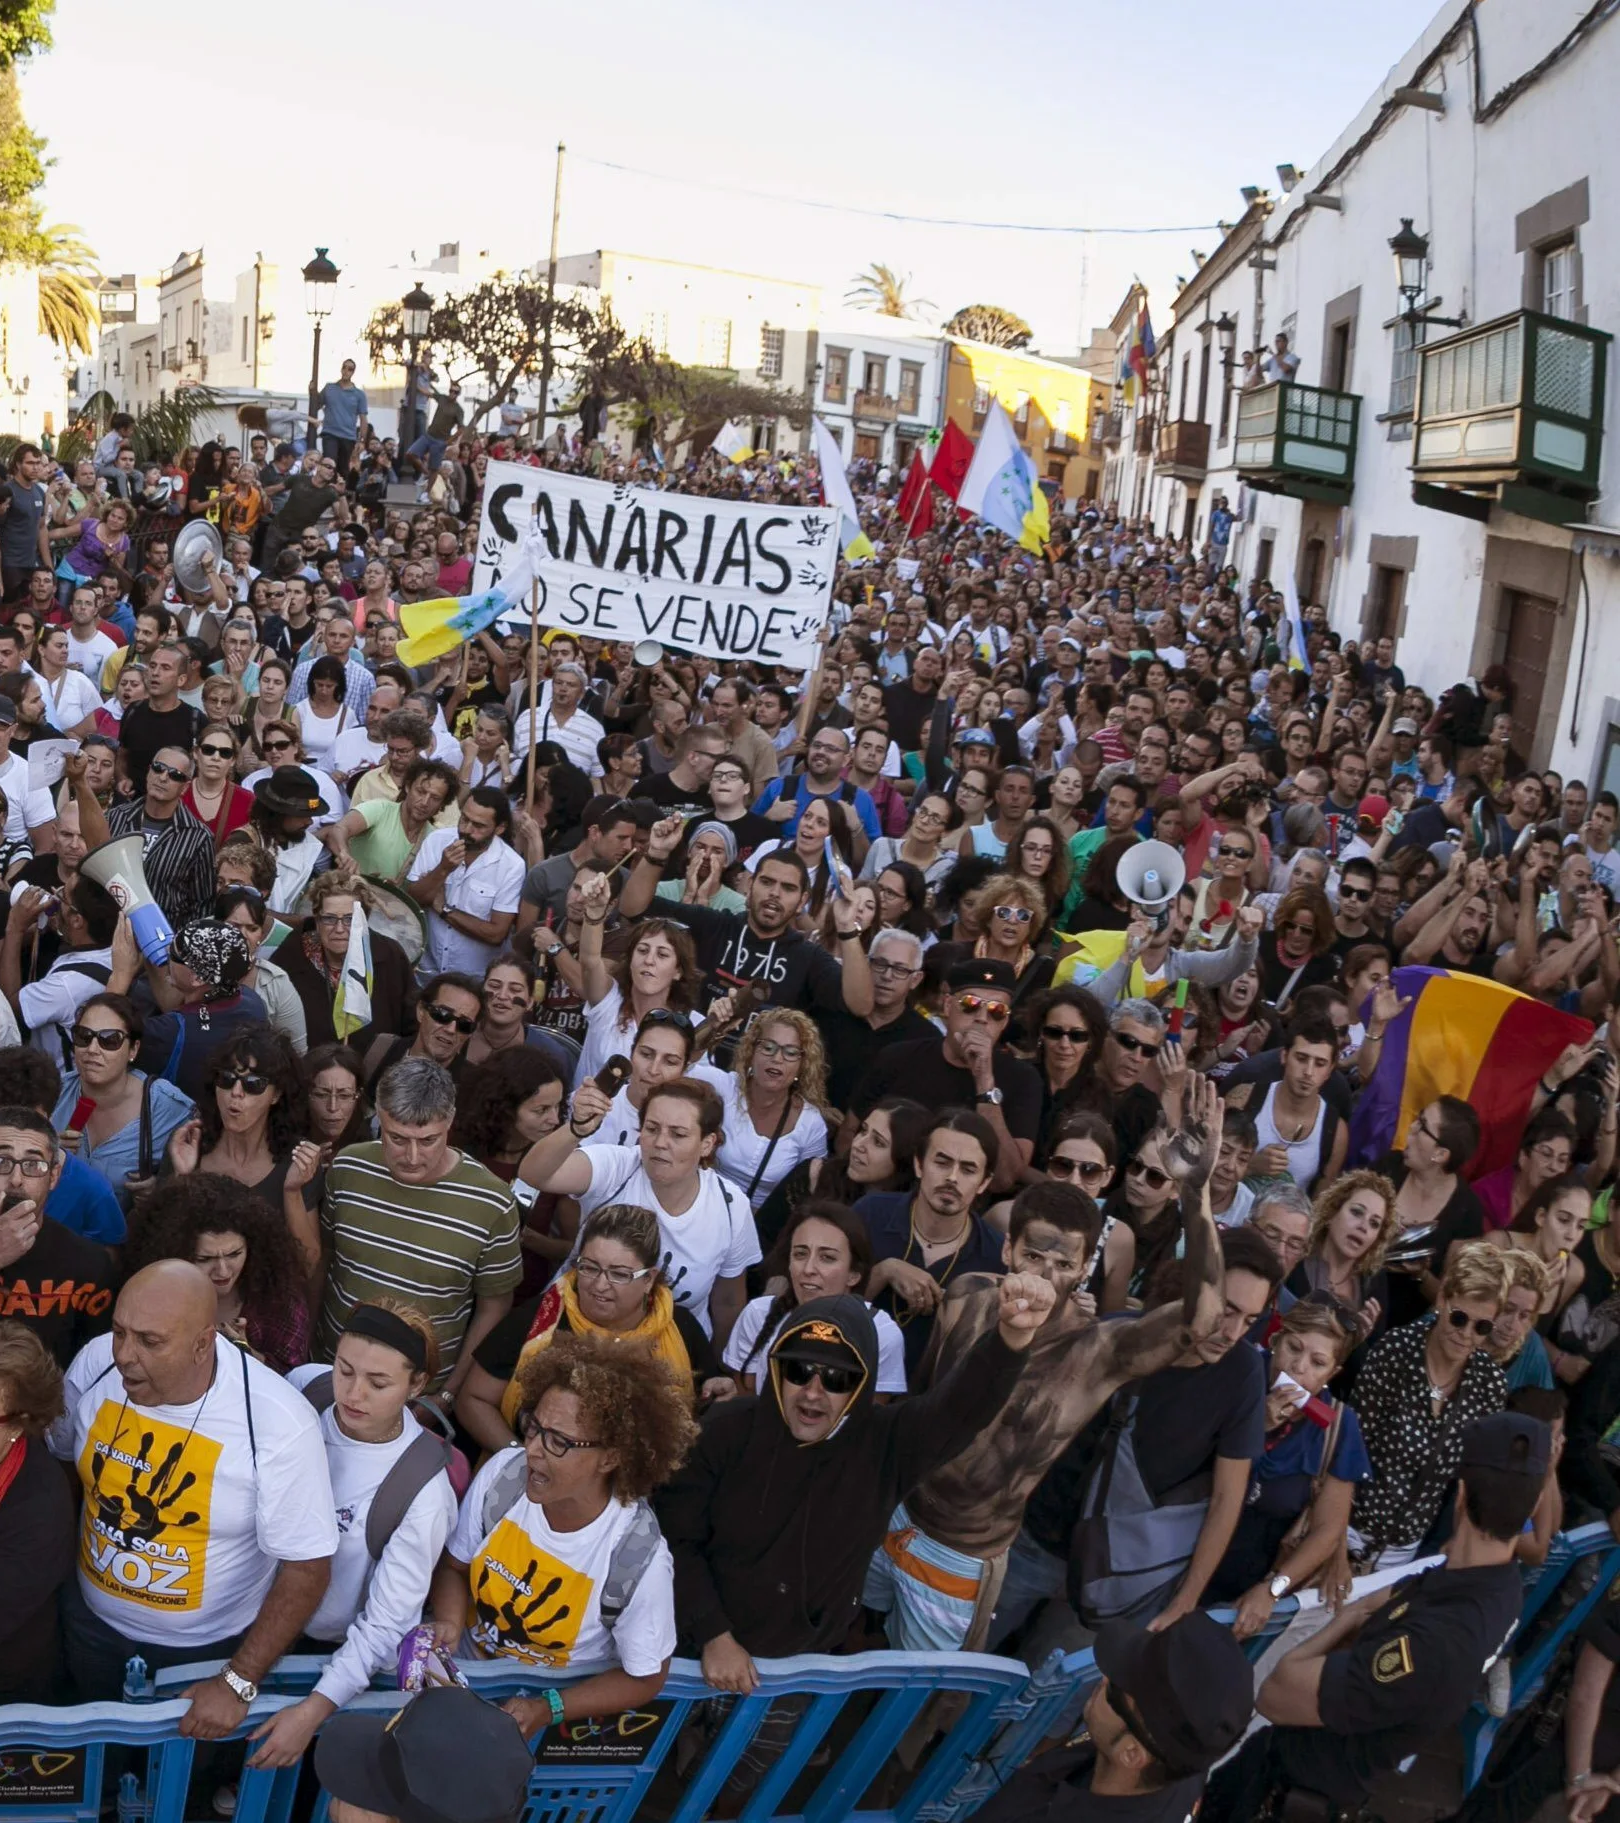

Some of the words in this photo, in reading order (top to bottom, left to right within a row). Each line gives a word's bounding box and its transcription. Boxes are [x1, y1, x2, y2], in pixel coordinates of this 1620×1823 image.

[488, 483, 792, 595] CANARIAS
[560, 583, 624, 629] SE
[635, 593, 797, 658] VENDE
[95, 1441, 152, 1473] CANARIAS
[89, 1532, 191, 1597] VOZ
[130, 1536, 190, 1563] SOLA
[105, 1579, 120, 1592] LAS
[484, 1555, 534, 1597] CANARIAS
